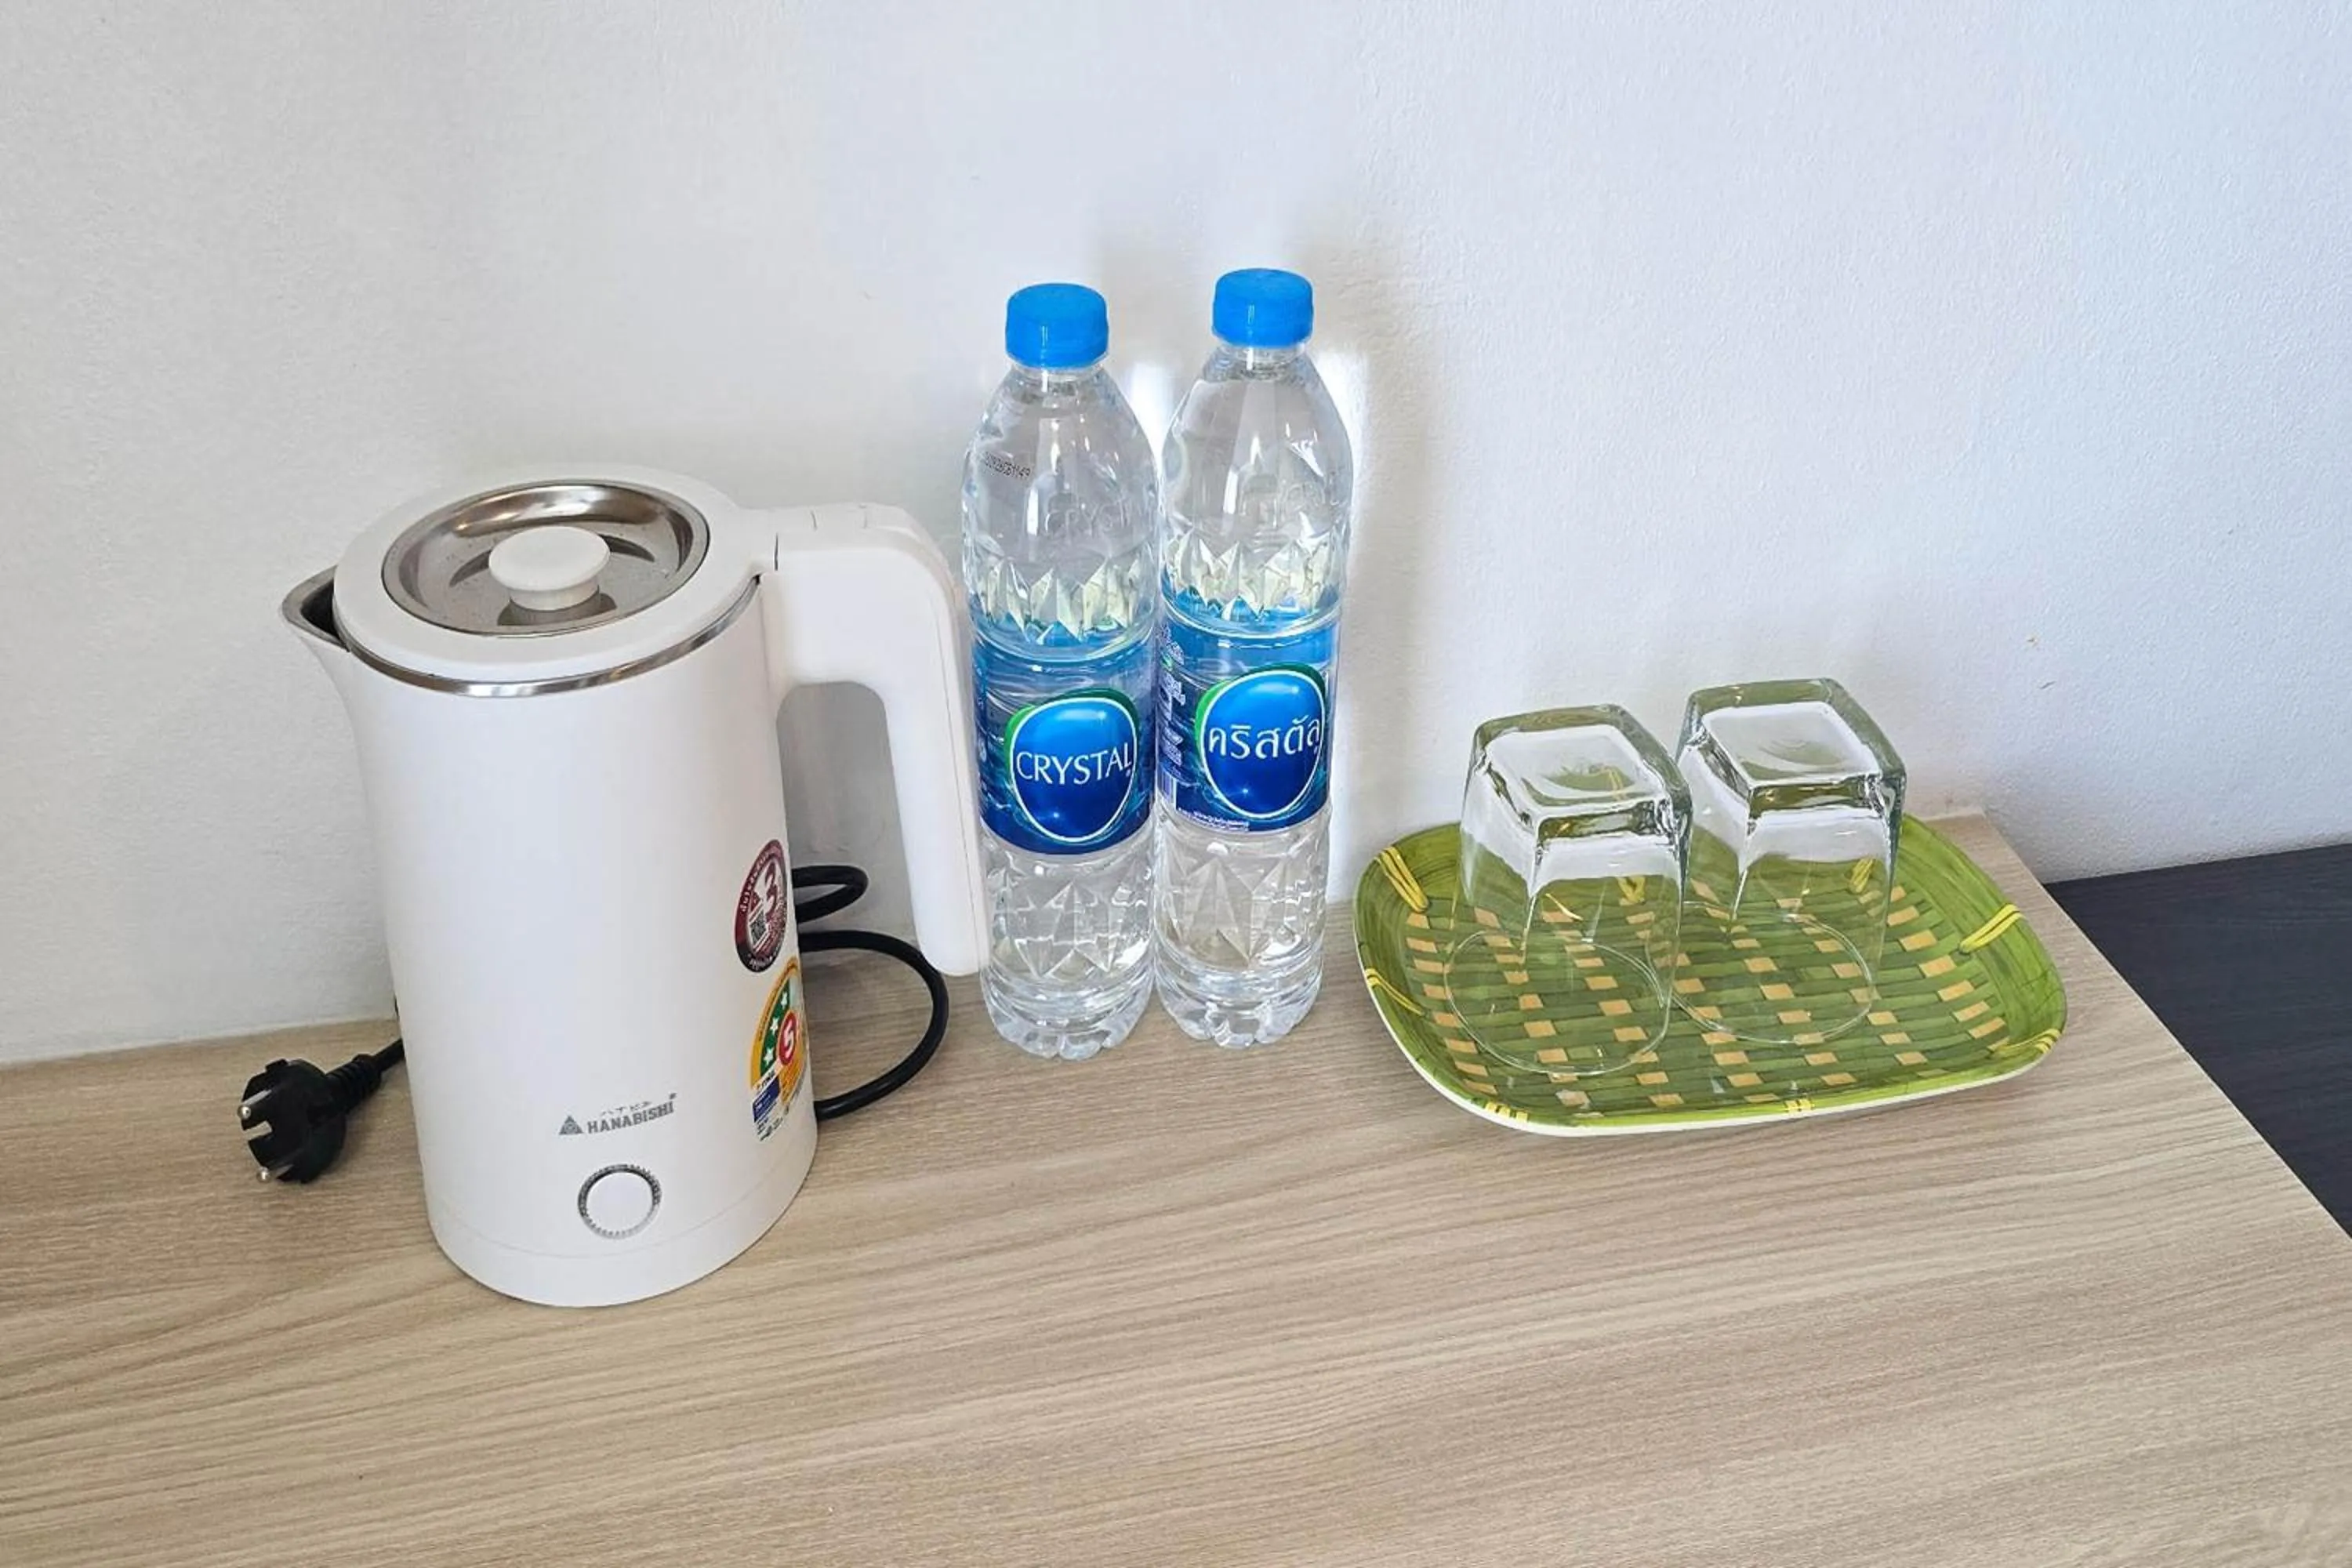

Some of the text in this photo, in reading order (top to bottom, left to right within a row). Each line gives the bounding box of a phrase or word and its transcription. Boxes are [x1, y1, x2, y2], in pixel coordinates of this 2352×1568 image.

[1209, 714, 1319, 760] คริสตัล
[1016, 742, 1132, 785] CRYSTAL
[783, 1019, 794, 1058] 5
[587, 1101, 673, 1134] HANABISHI
